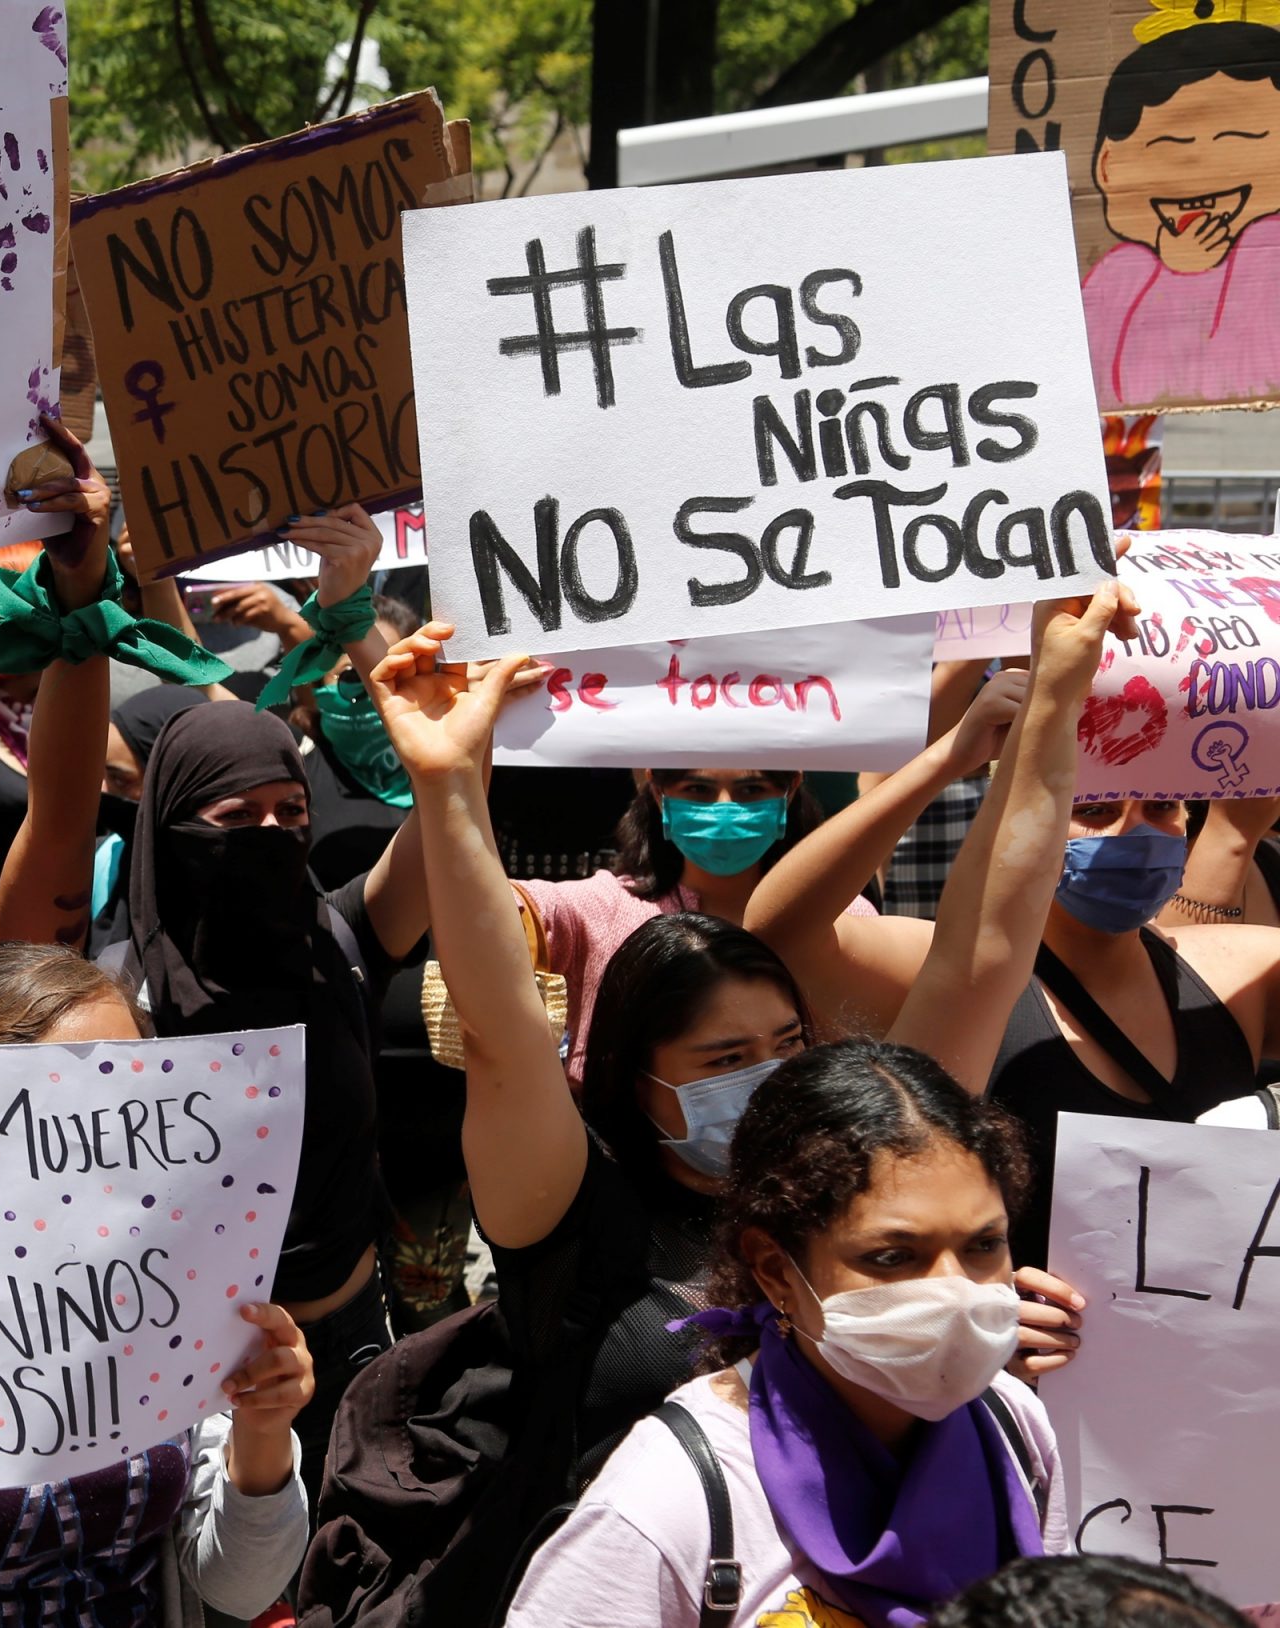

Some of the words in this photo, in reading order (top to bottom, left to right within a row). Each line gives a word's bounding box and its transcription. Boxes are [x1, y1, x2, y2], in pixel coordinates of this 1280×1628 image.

[106, 206, 215, 333] NO
[242, 136, 422, 277] SOMOS
[227, 332, 379, 434] SOMOS
[752, 375, 1040, 488] Niñas
[468, 494, 639, 639] NO
[672, 495, 832, 608] Se
[833, 479, 1118, 590] Tocan
[545, 667, 623, 714] se
[656, 653, 842, 722] tocan
